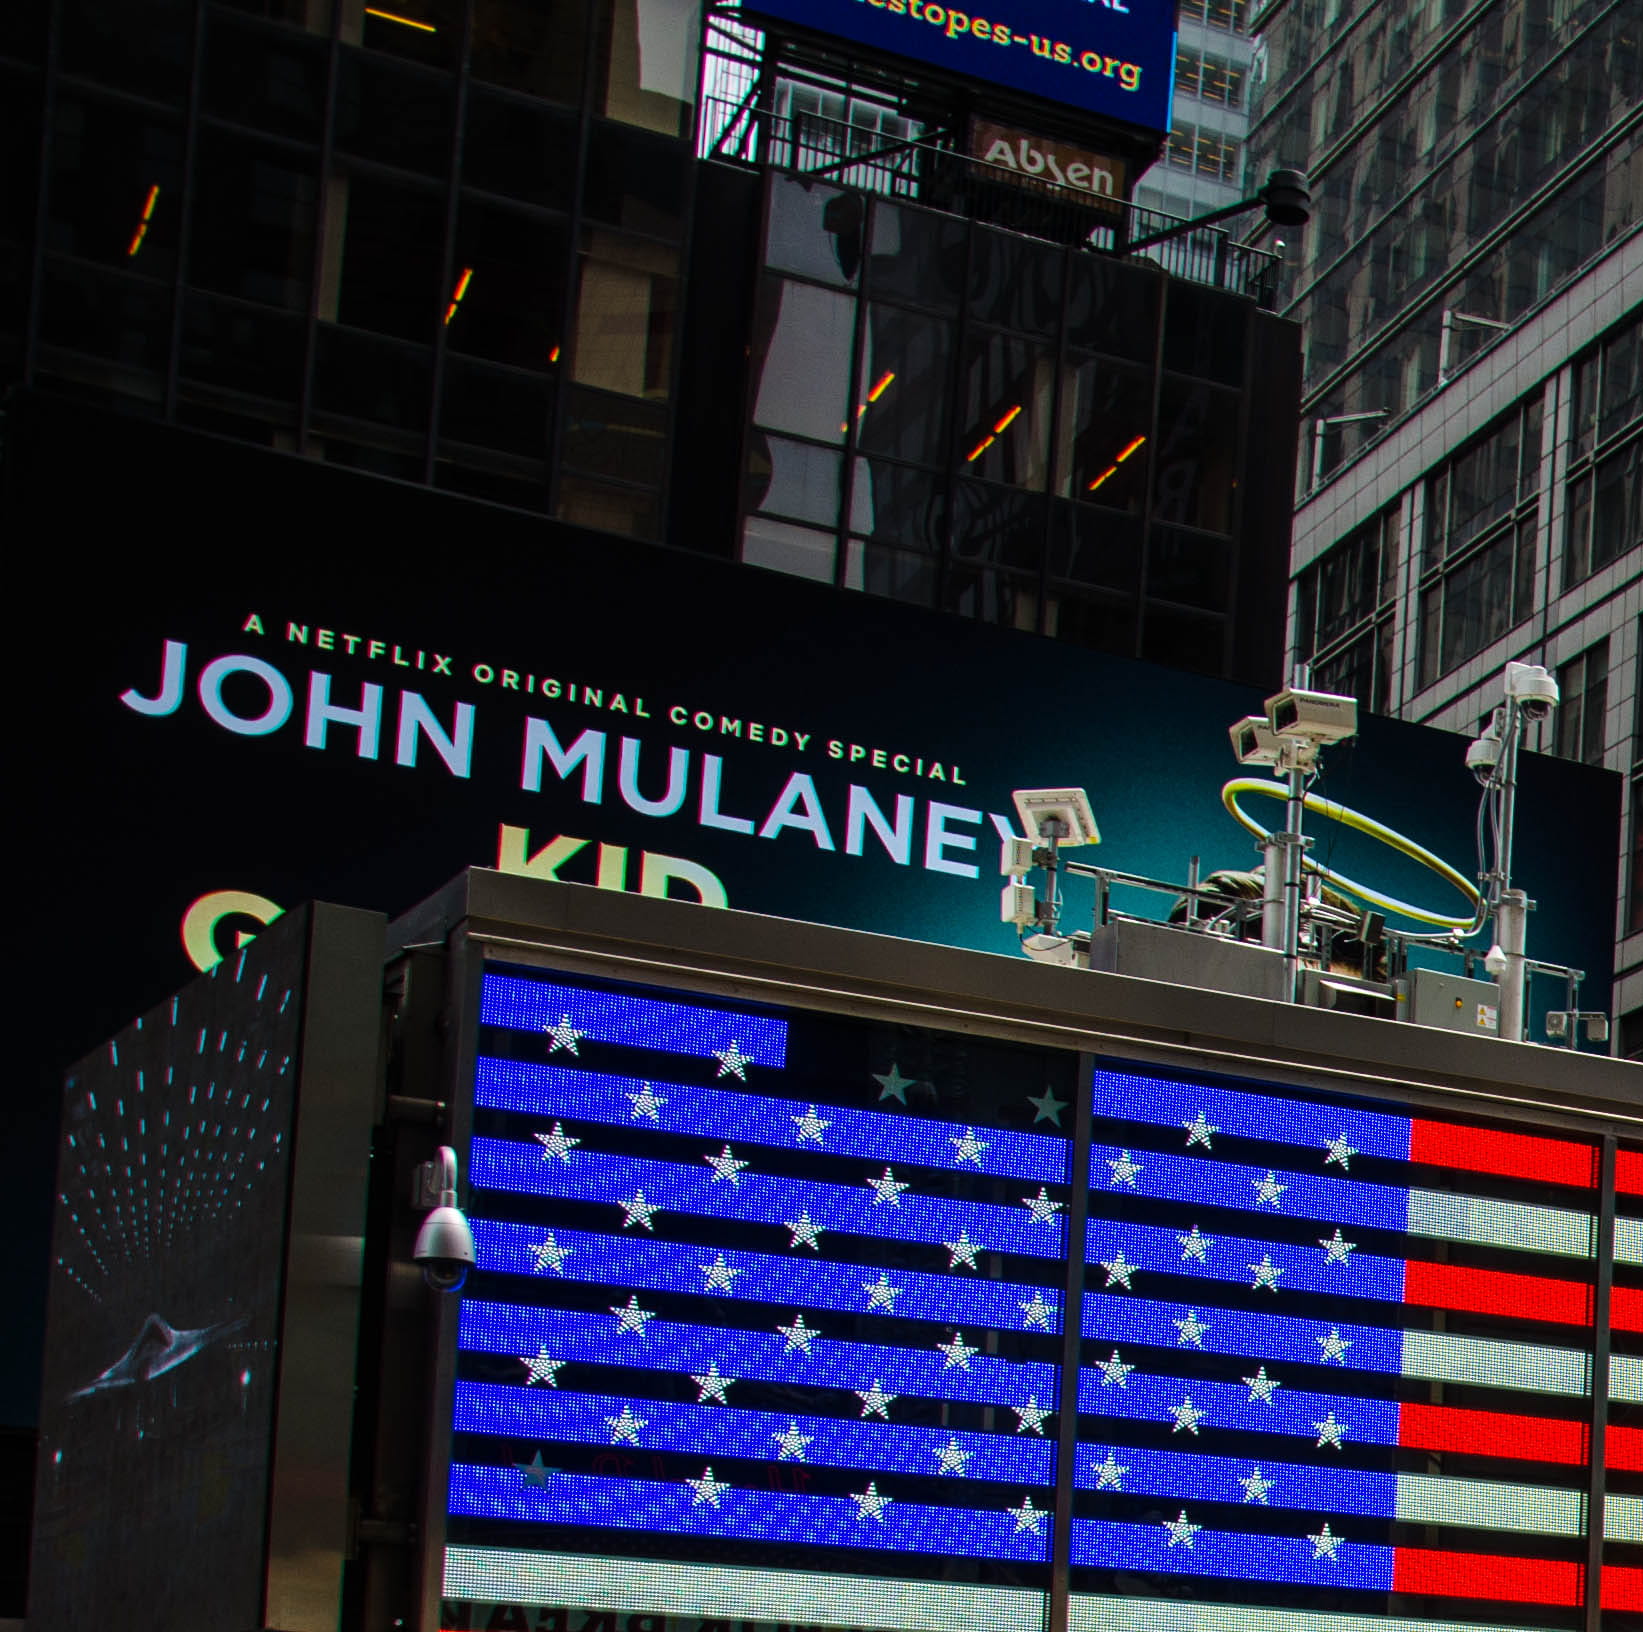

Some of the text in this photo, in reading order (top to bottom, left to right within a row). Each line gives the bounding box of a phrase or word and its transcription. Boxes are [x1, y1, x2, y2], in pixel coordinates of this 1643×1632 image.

[119, 638, 474, 779] JOHN
[243, 613, 968, 786] A NETFLIX ORIGINAL COMEDY SPECIAL
